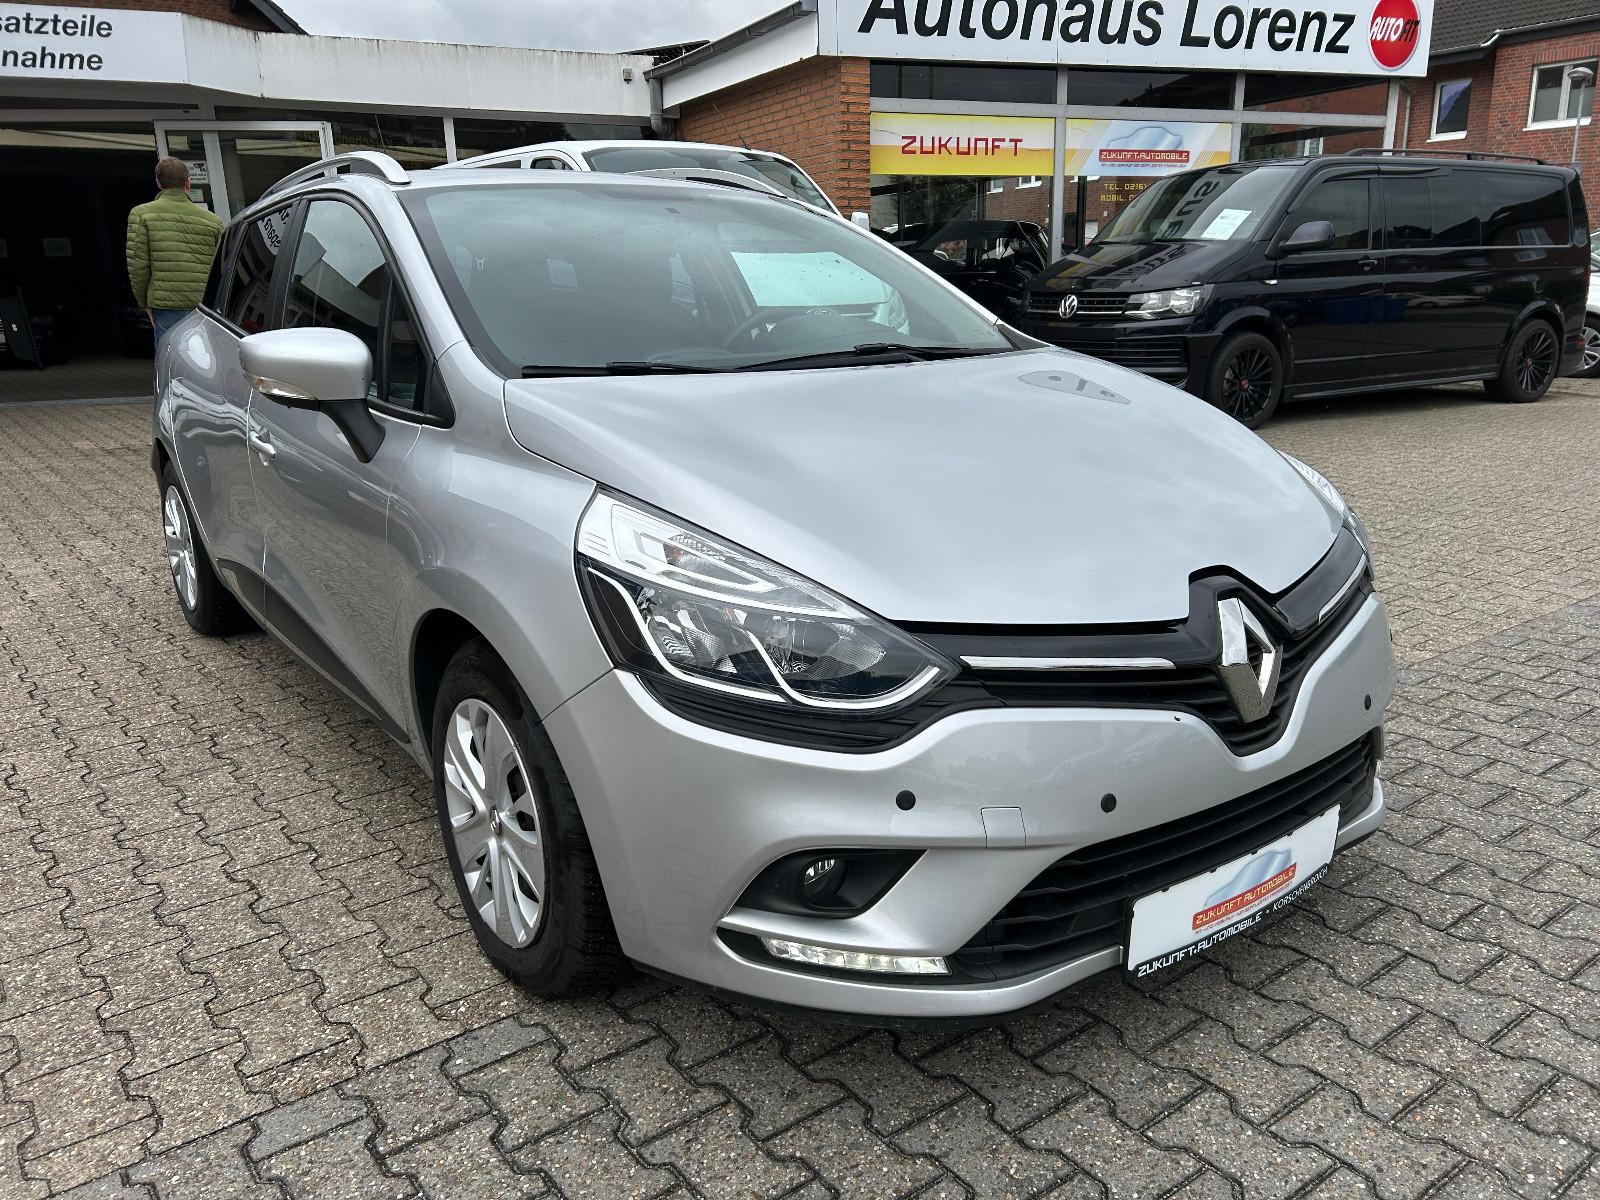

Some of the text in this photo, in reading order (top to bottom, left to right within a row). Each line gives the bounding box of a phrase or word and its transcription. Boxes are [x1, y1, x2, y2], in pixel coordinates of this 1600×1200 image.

[0, 12, 113, 38] atzteile
[1180, 0, 1356, 54] Lorenz
[2, 46, 104, 71] nahme
[901, 135, 1023, 157] ZUKUNFT
